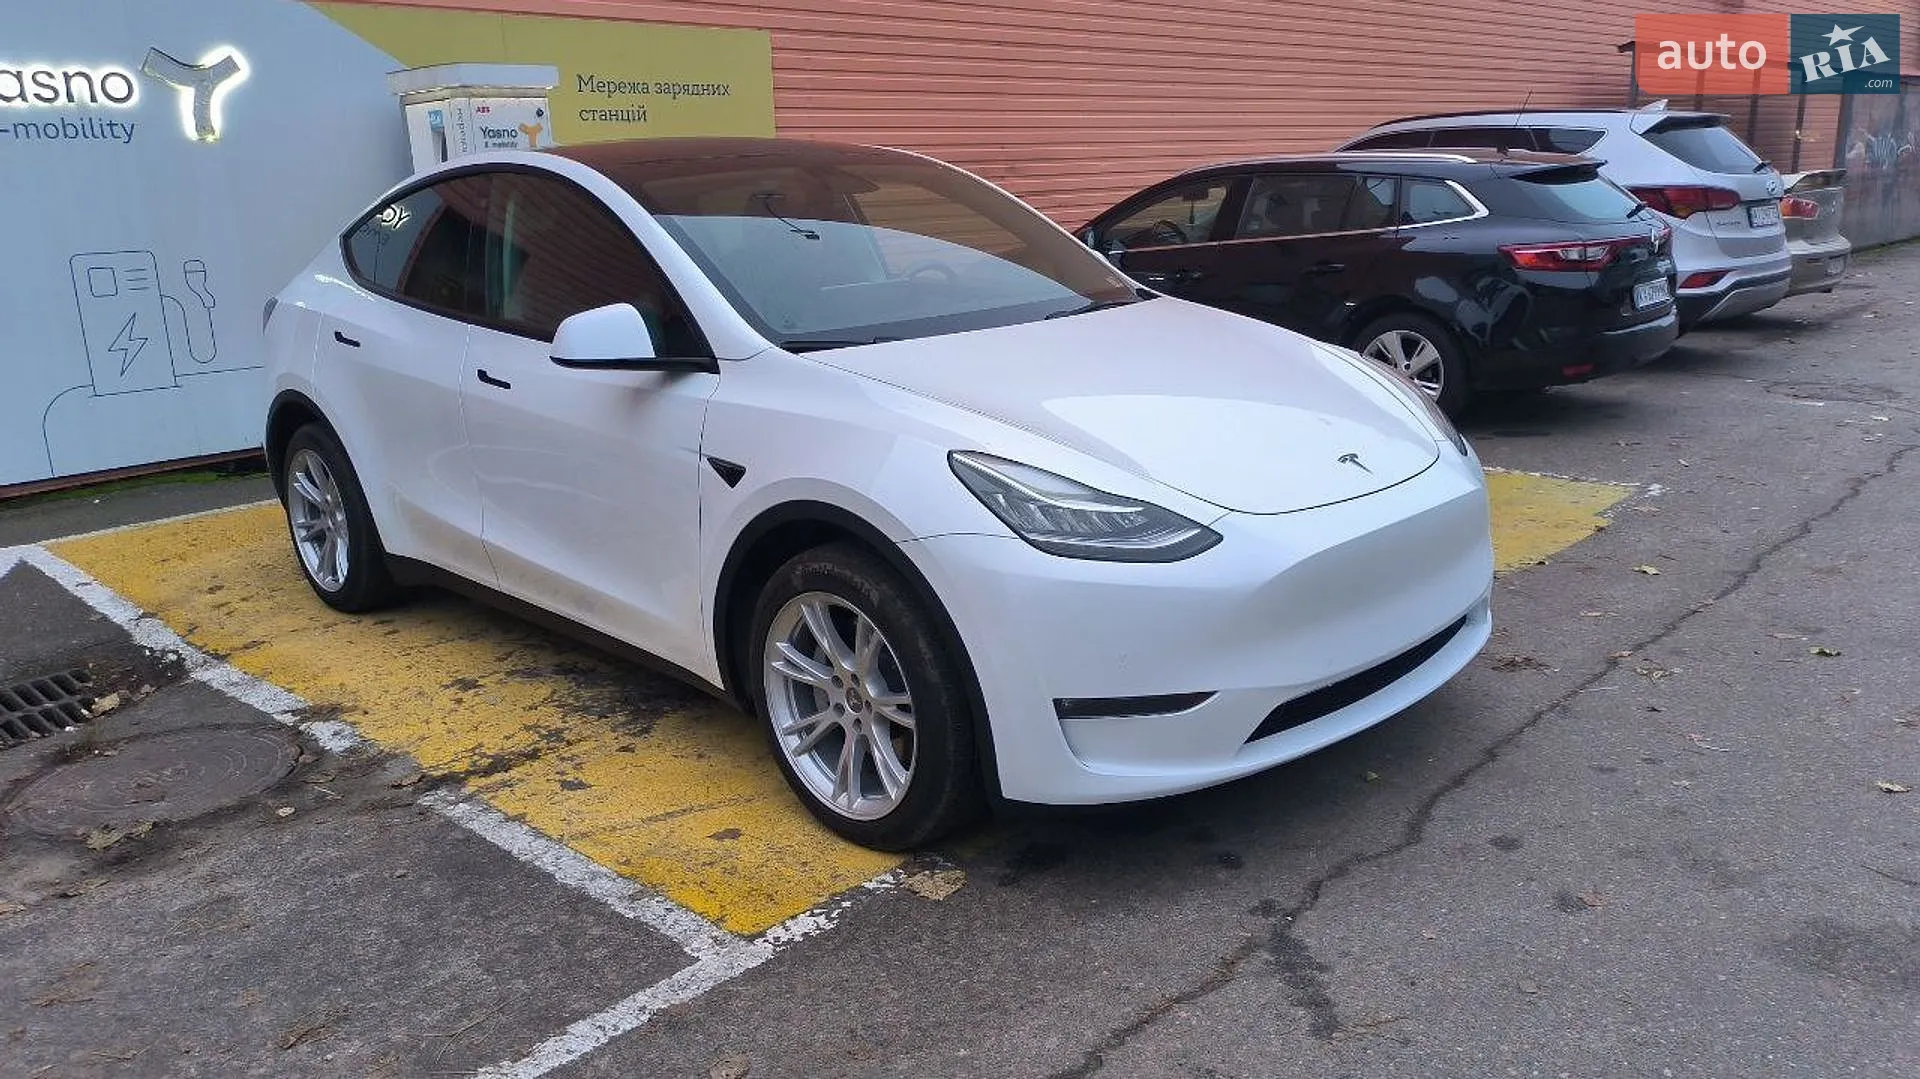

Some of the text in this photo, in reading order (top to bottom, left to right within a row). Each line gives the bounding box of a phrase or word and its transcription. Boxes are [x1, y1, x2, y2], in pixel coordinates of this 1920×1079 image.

[576, 73, 731, 100] Мережа зарядних
[579, 104, 648, 123] станцій
[480, 126, 518, 139] Yasno
